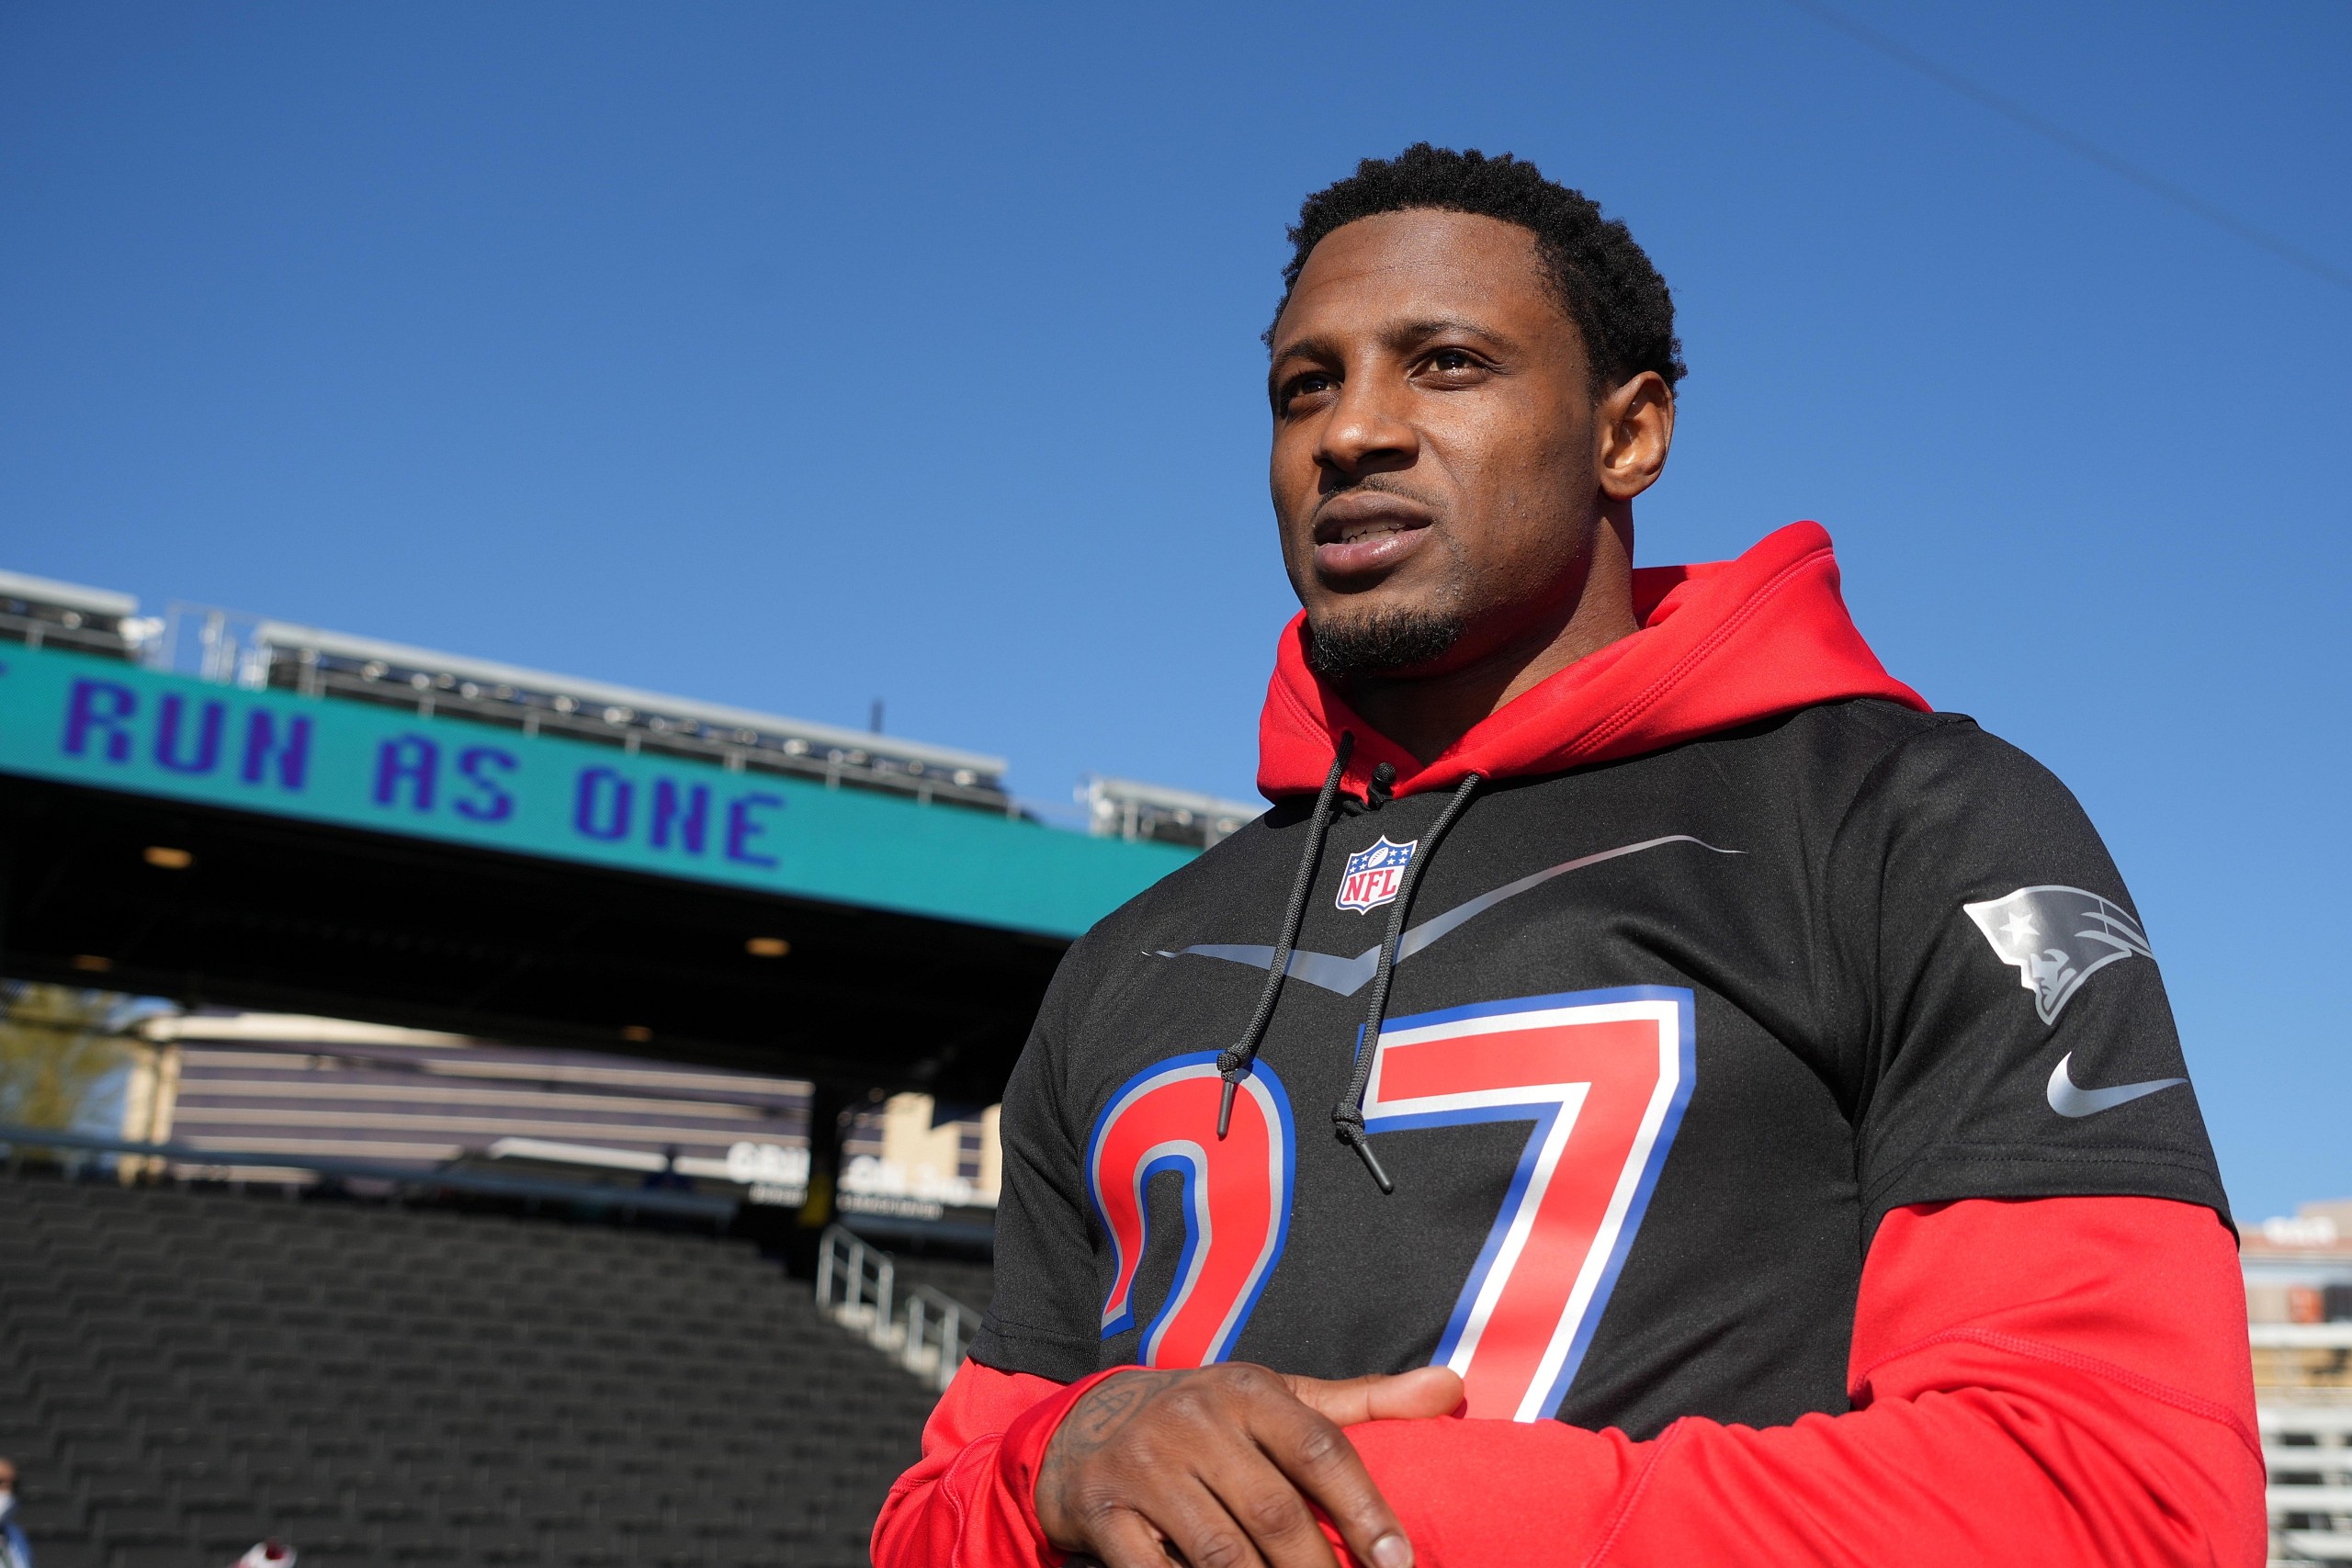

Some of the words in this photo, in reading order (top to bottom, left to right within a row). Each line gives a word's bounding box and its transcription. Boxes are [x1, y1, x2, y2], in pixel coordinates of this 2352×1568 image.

[62, 676, 314, 792] RUN
[374, 733, 519, 824] AS
[573, 764, 786, 870] ONE
[1343, 869, 1396, 902] NFL
